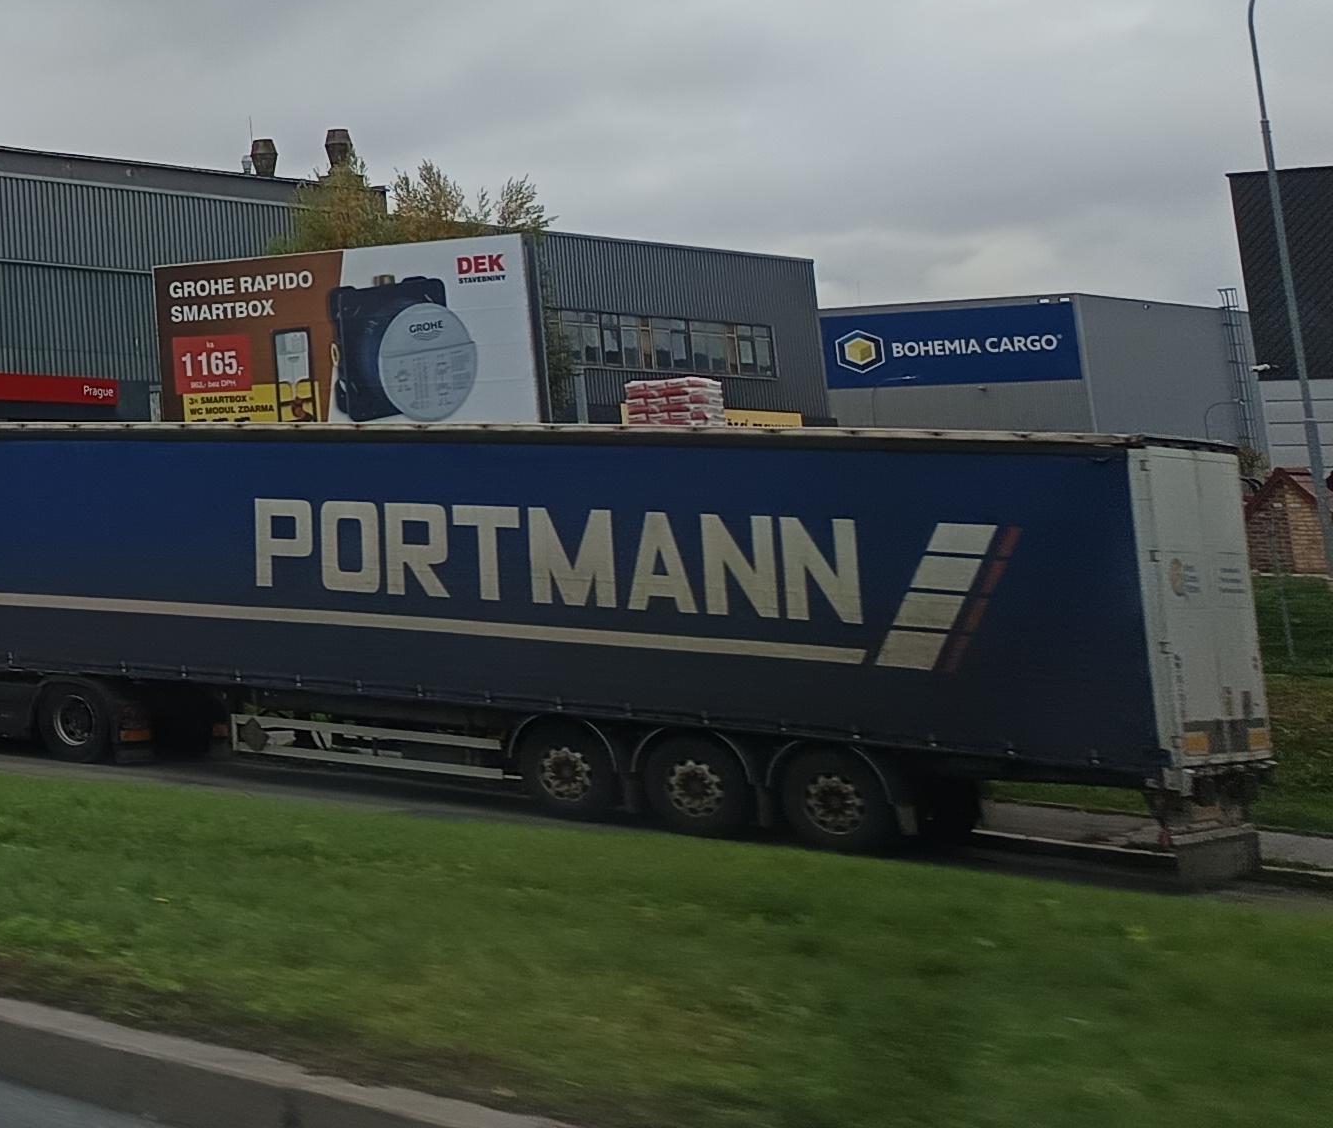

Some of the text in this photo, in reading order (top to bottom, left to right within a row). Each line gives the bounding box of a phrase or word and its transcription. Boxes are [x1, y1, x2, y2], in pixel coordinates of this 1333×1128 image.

[457, 254, 505, 275] DEK
[169, 270, 313, 298] GROHE RAPIDO
[458, 275, 507, 285] STAVEBNINY
[170, 299, 276, 322] SMARTBOX
[409, 320, 445, 333] GROHE
[892, 333, 1058, 358] BOHEMIA CARGO
[207, 380, 220, 388] bez
[220, 379, 236, 387] DPH
[83, 385, 114, 399] Prague
[200, 395, 247, 405] SMARTBOX
[189, 404, 275, 416] WC MODUL ZDARMA
[254, 497, 864, 625] PORTMANN
